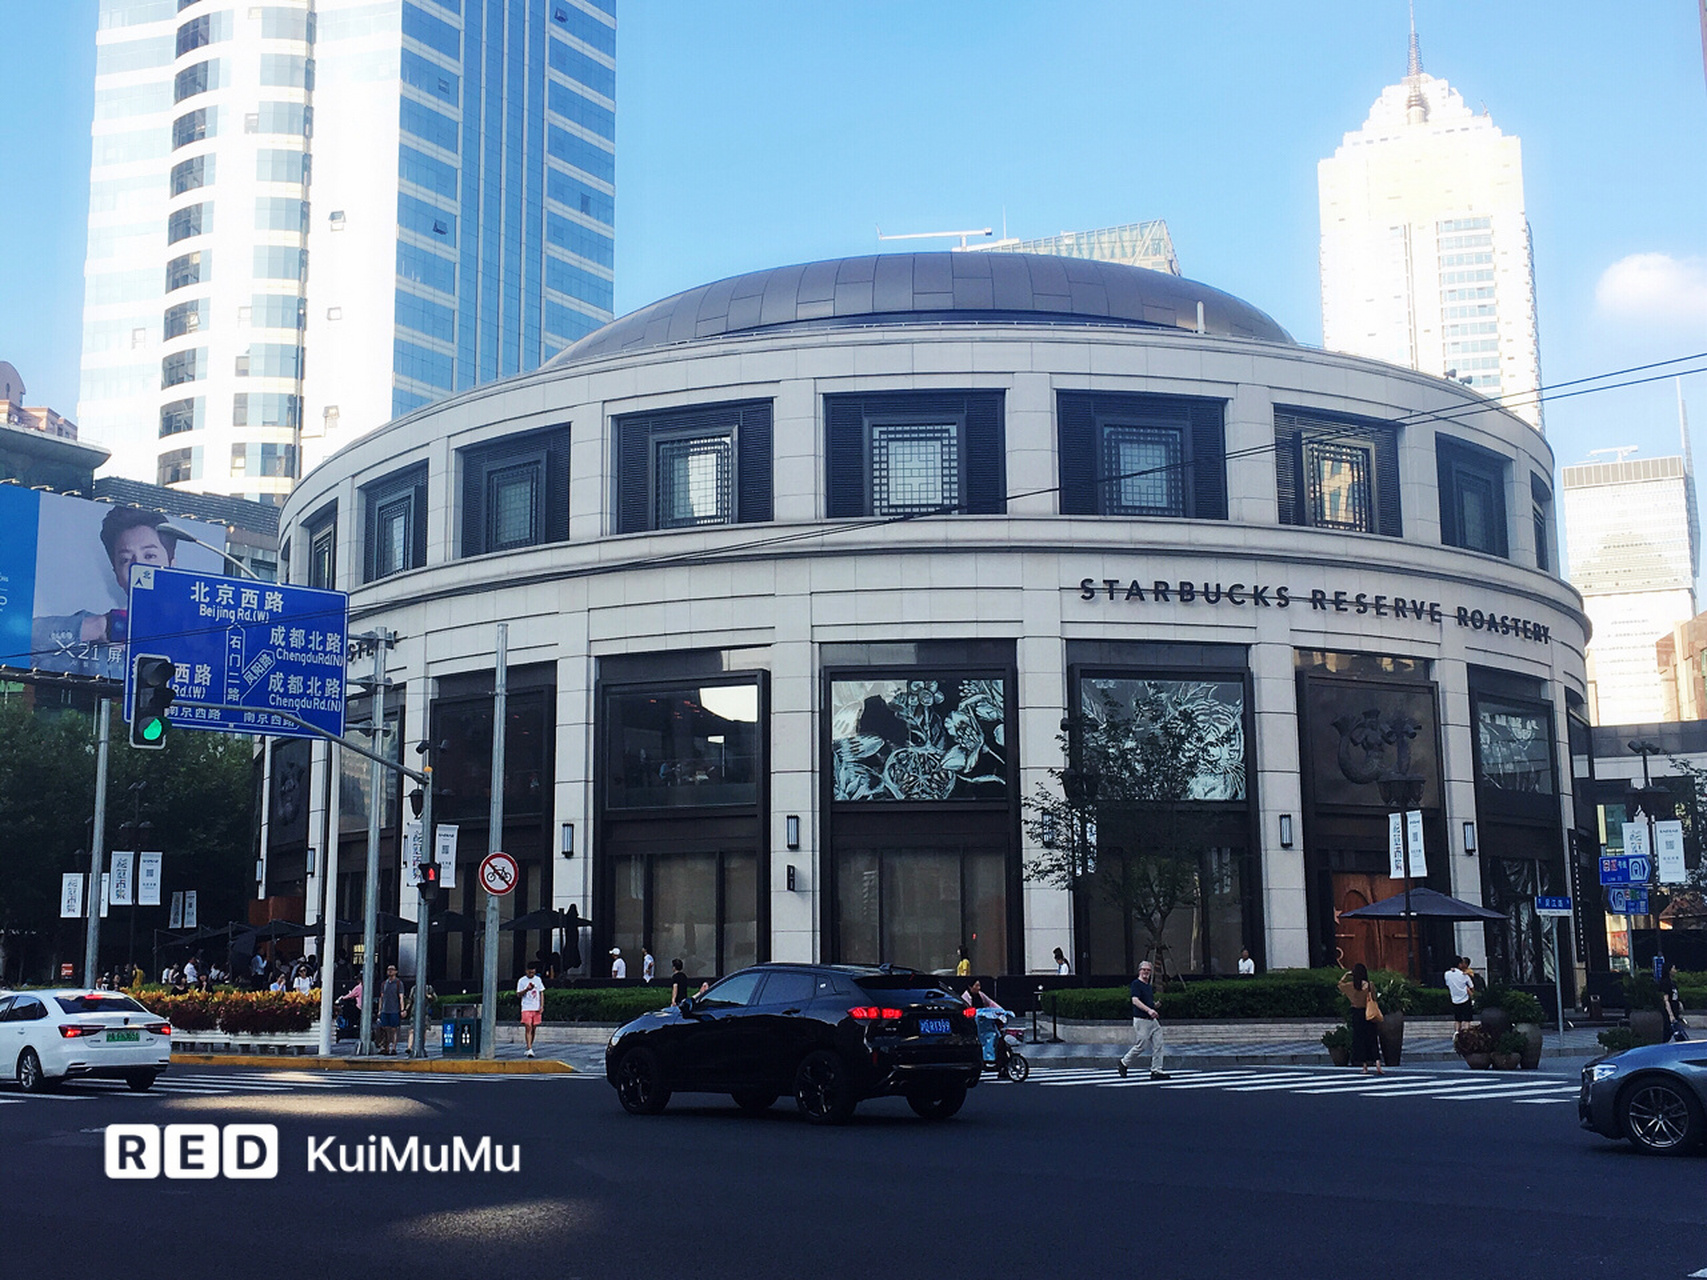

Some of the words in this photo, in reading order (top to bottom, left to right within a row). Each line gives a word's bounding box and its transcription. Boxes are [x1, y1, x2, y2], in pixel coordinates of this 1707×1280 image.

[190, 581, 284, 613] 北京西路
[1080, 578, 1291, 608] STARBUCKS
[1311, 588, 1442, 623] RESERVE
[1457, 606, 1550, 645] ROASTERY
[199, 604, 236, 622] Beijing
[237, 608, 270, 624] Rd.(W)
[54, 639, 99, 661] X21
[107, 647, 122, 663] 屏
[269, 625, 342, 654] 成都北路
[227, 635, 242, 701] 石门二路
[243, 653, 273, 686] 凤阳路
[268, 671, 341, 699] 成都北路
